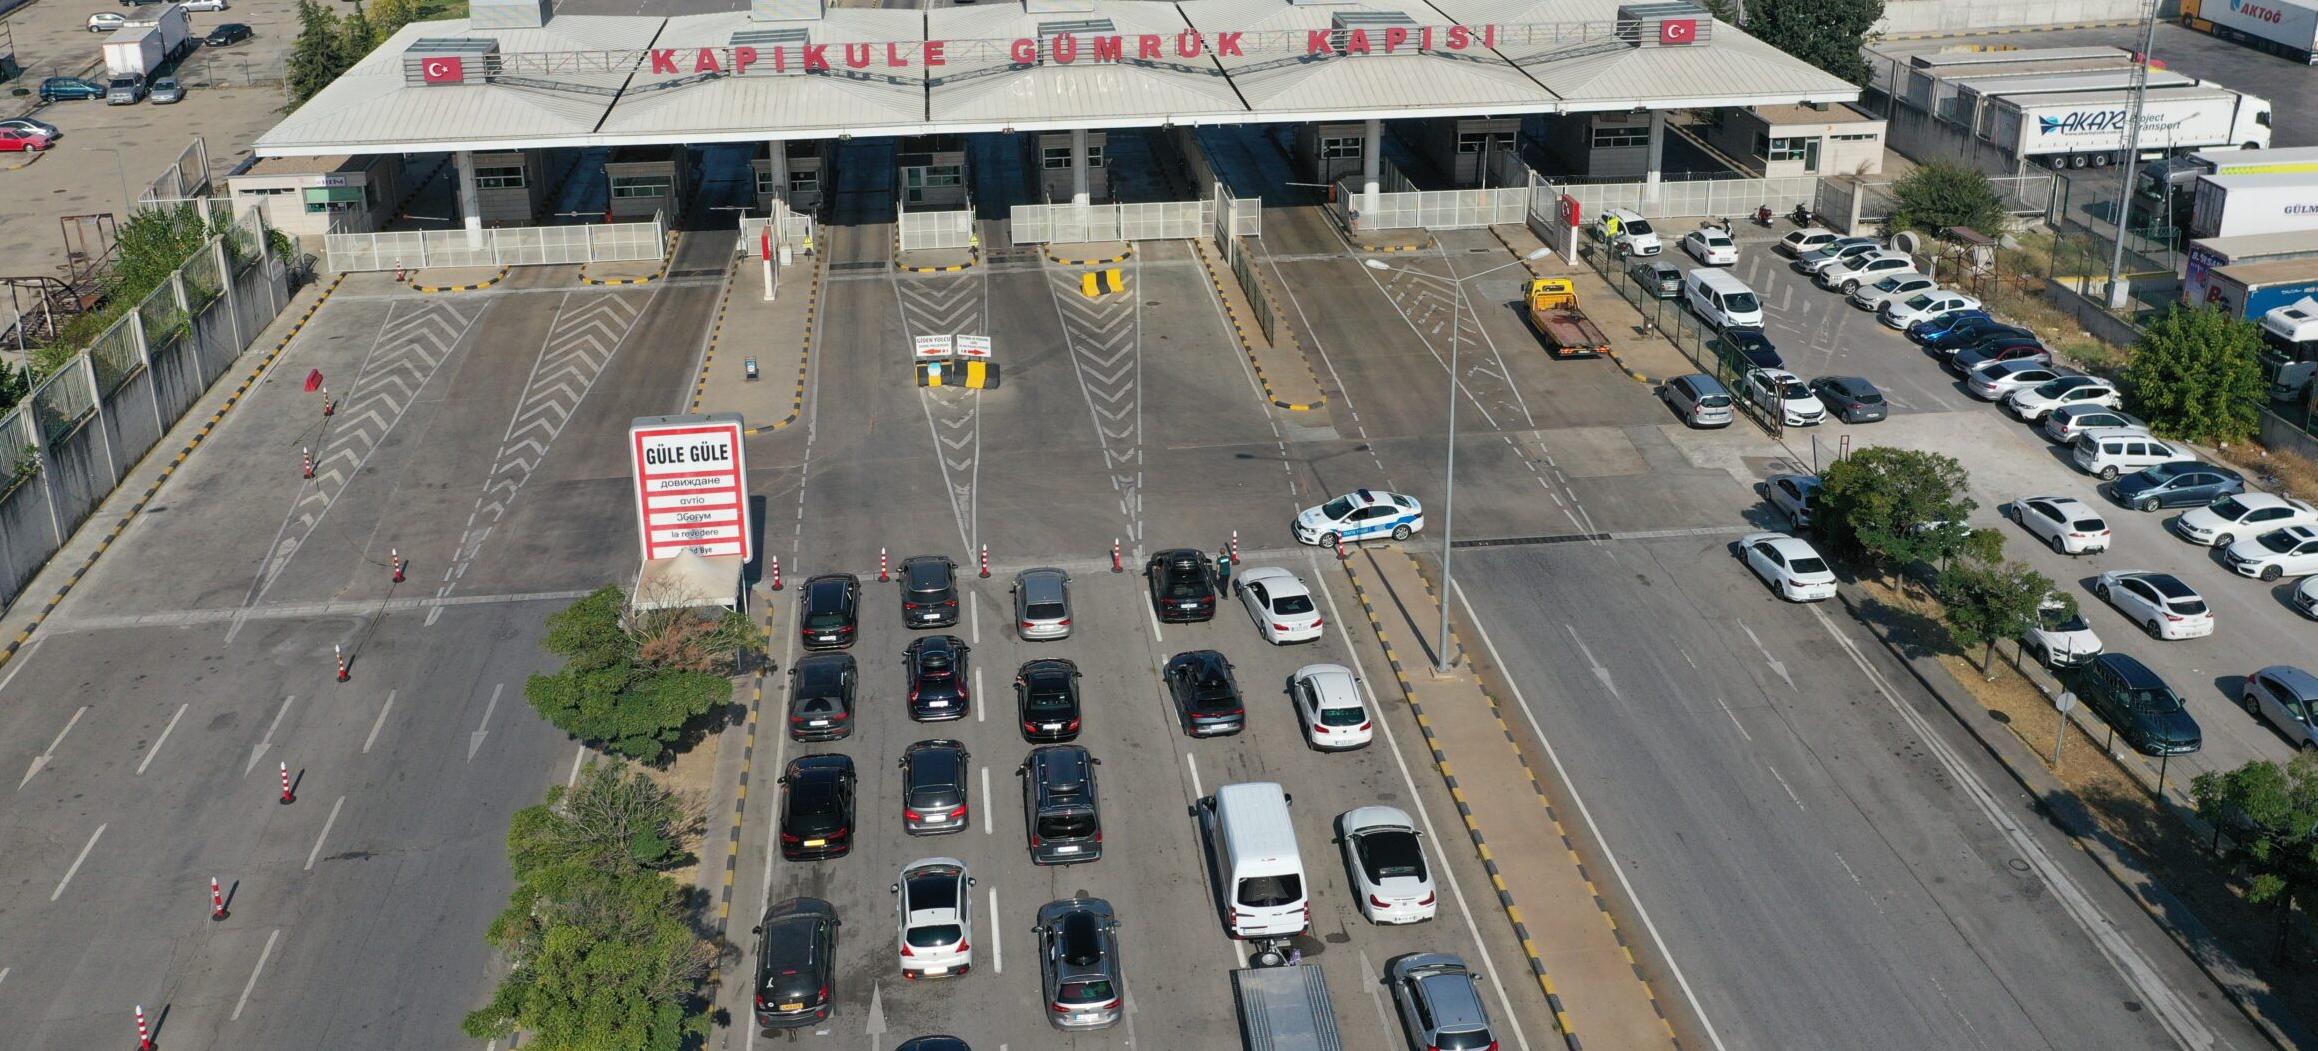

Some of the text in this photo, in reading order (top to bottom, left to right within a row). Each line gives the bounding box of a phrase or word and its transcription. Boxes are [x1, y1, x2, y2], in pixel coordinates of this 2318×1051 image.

[2240, 3, 2282, 24] AKTOĞ
[651, 24, 1495, 74] KAPIKULE GÜMRÜK KAPISI
[2061, 110, 2127, 134] AKAR
[2137, 121, 2181, 131] ransport
[646, 441, 728, 465] GÜLE GÜLE
[660, 477, 720, 489] довиждане
[671, 529, 719, 538] la revedere
